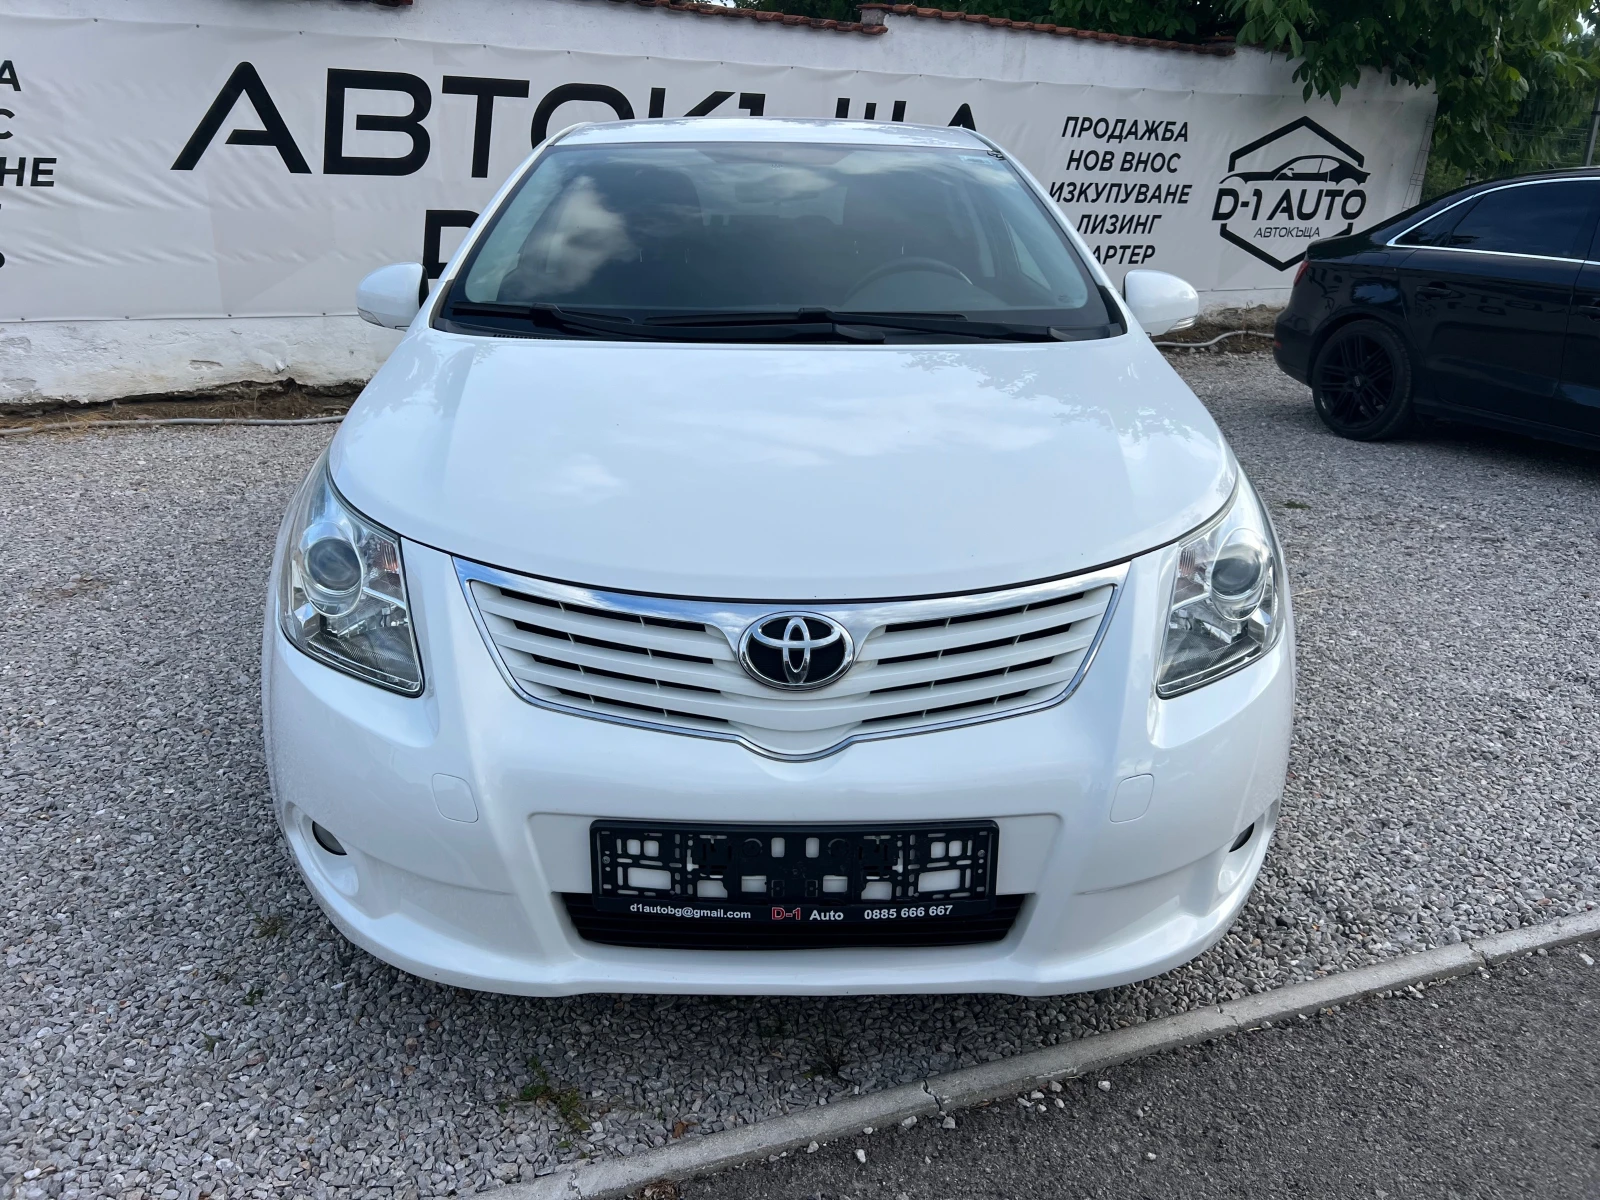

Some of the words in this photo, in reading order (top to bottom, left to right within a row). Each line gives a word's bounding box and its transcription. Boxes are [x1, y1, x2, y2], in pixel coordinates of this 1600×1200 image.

[1062, 116, 1188, 143] ПРОДАЖБА
[1066, 150, 1115, 171] НОВ
[1120, 152, 1181, 173] ВНОС
[1049, 182, 1192, 204] ИЗКУПУВАНЕ
[1212, 188, 1263, 221] D-1
[1266, 188, 1367, 221] AUTO
[1077, 214, 1162, 234] ЛИЗИНГ
[1254, 226, 1320, 239] АВТОКЪЩА
[1087, 245, 1156, 265] АРТЕР
[630, 903, 751, 919] d1autobg@gmail.com
[771, 906, 801, 920] D-1
[809, 910, 844, 921] Auto
[864, 909, 897, 920] 0885
[901, 907, 925, 918] 666
[929, 905, 953, 916] 667
